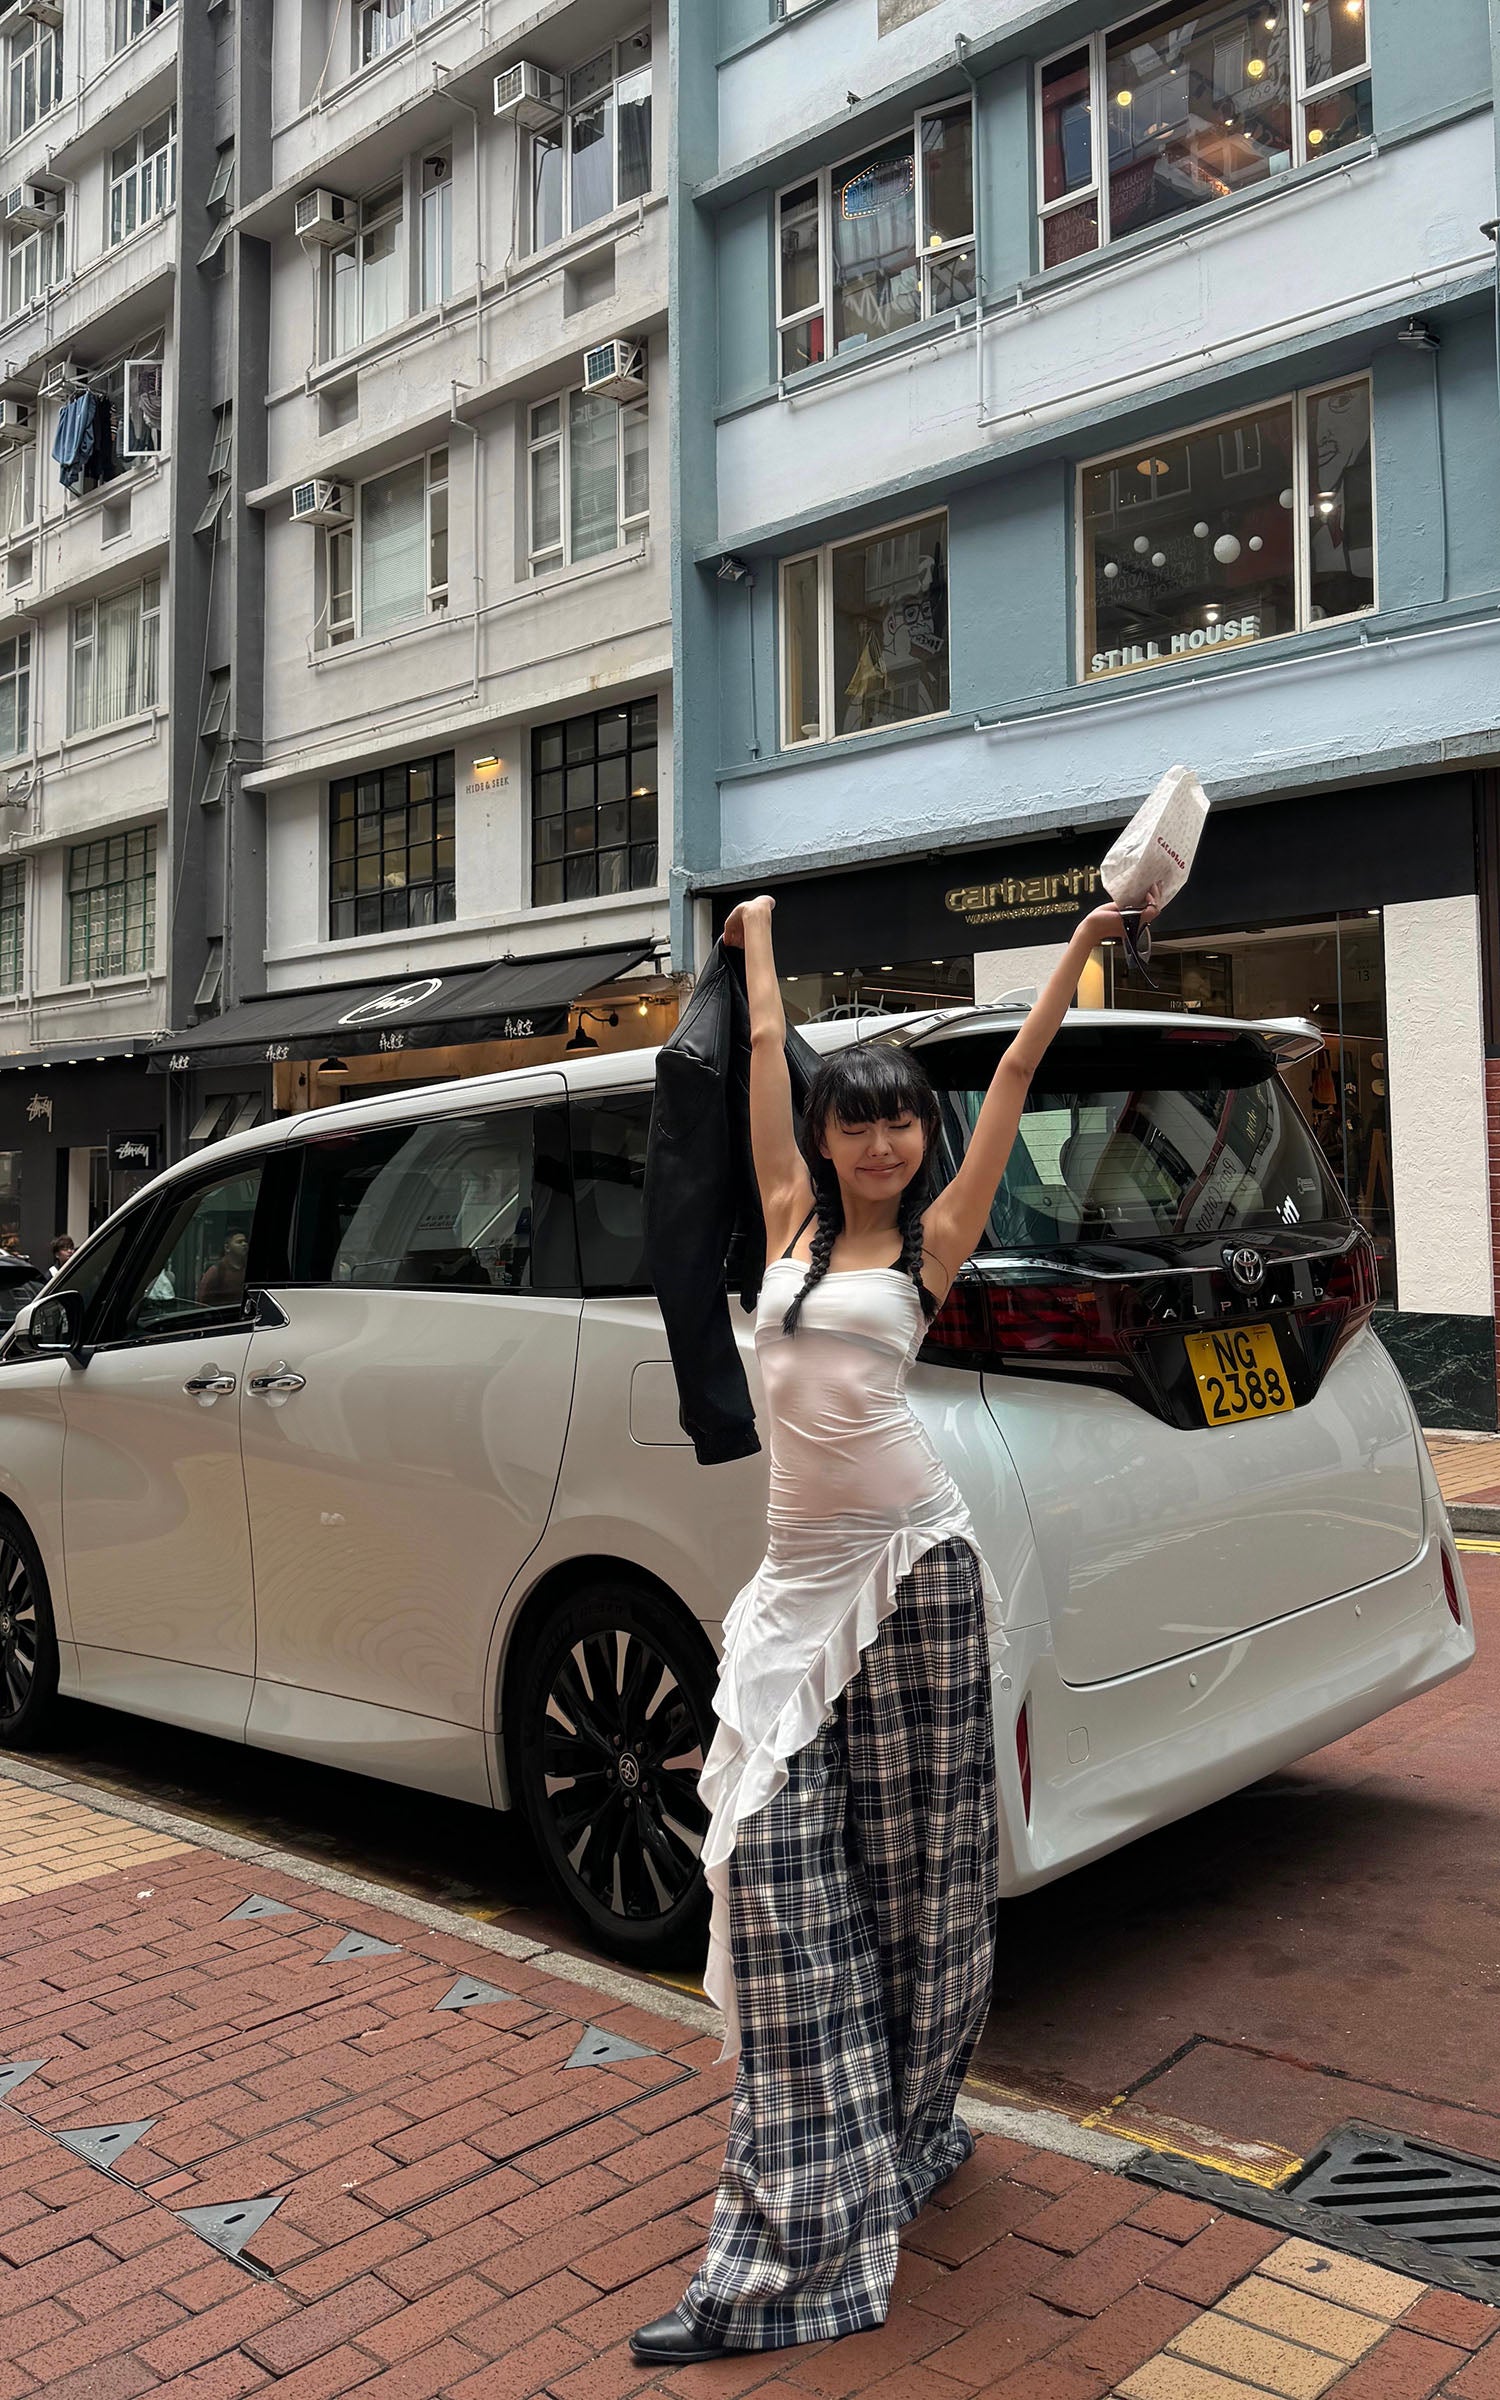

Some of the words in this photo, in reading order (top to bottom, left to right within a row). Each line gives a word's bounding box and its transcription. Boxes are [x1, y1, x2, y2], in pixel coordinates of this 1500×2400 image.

[1091, 641, 1162, 673] STILL
[1171, 615, 1261, 653] HOUSE
[465, 782, 484, 794] HIDE
[492, 776, 509, 788] SEEK
[945, 865, 1100, 911] carhartt
[1162, 1287, 1324, 1319] ALPHARD
[1211, 1331, 1257, 1374] NG
